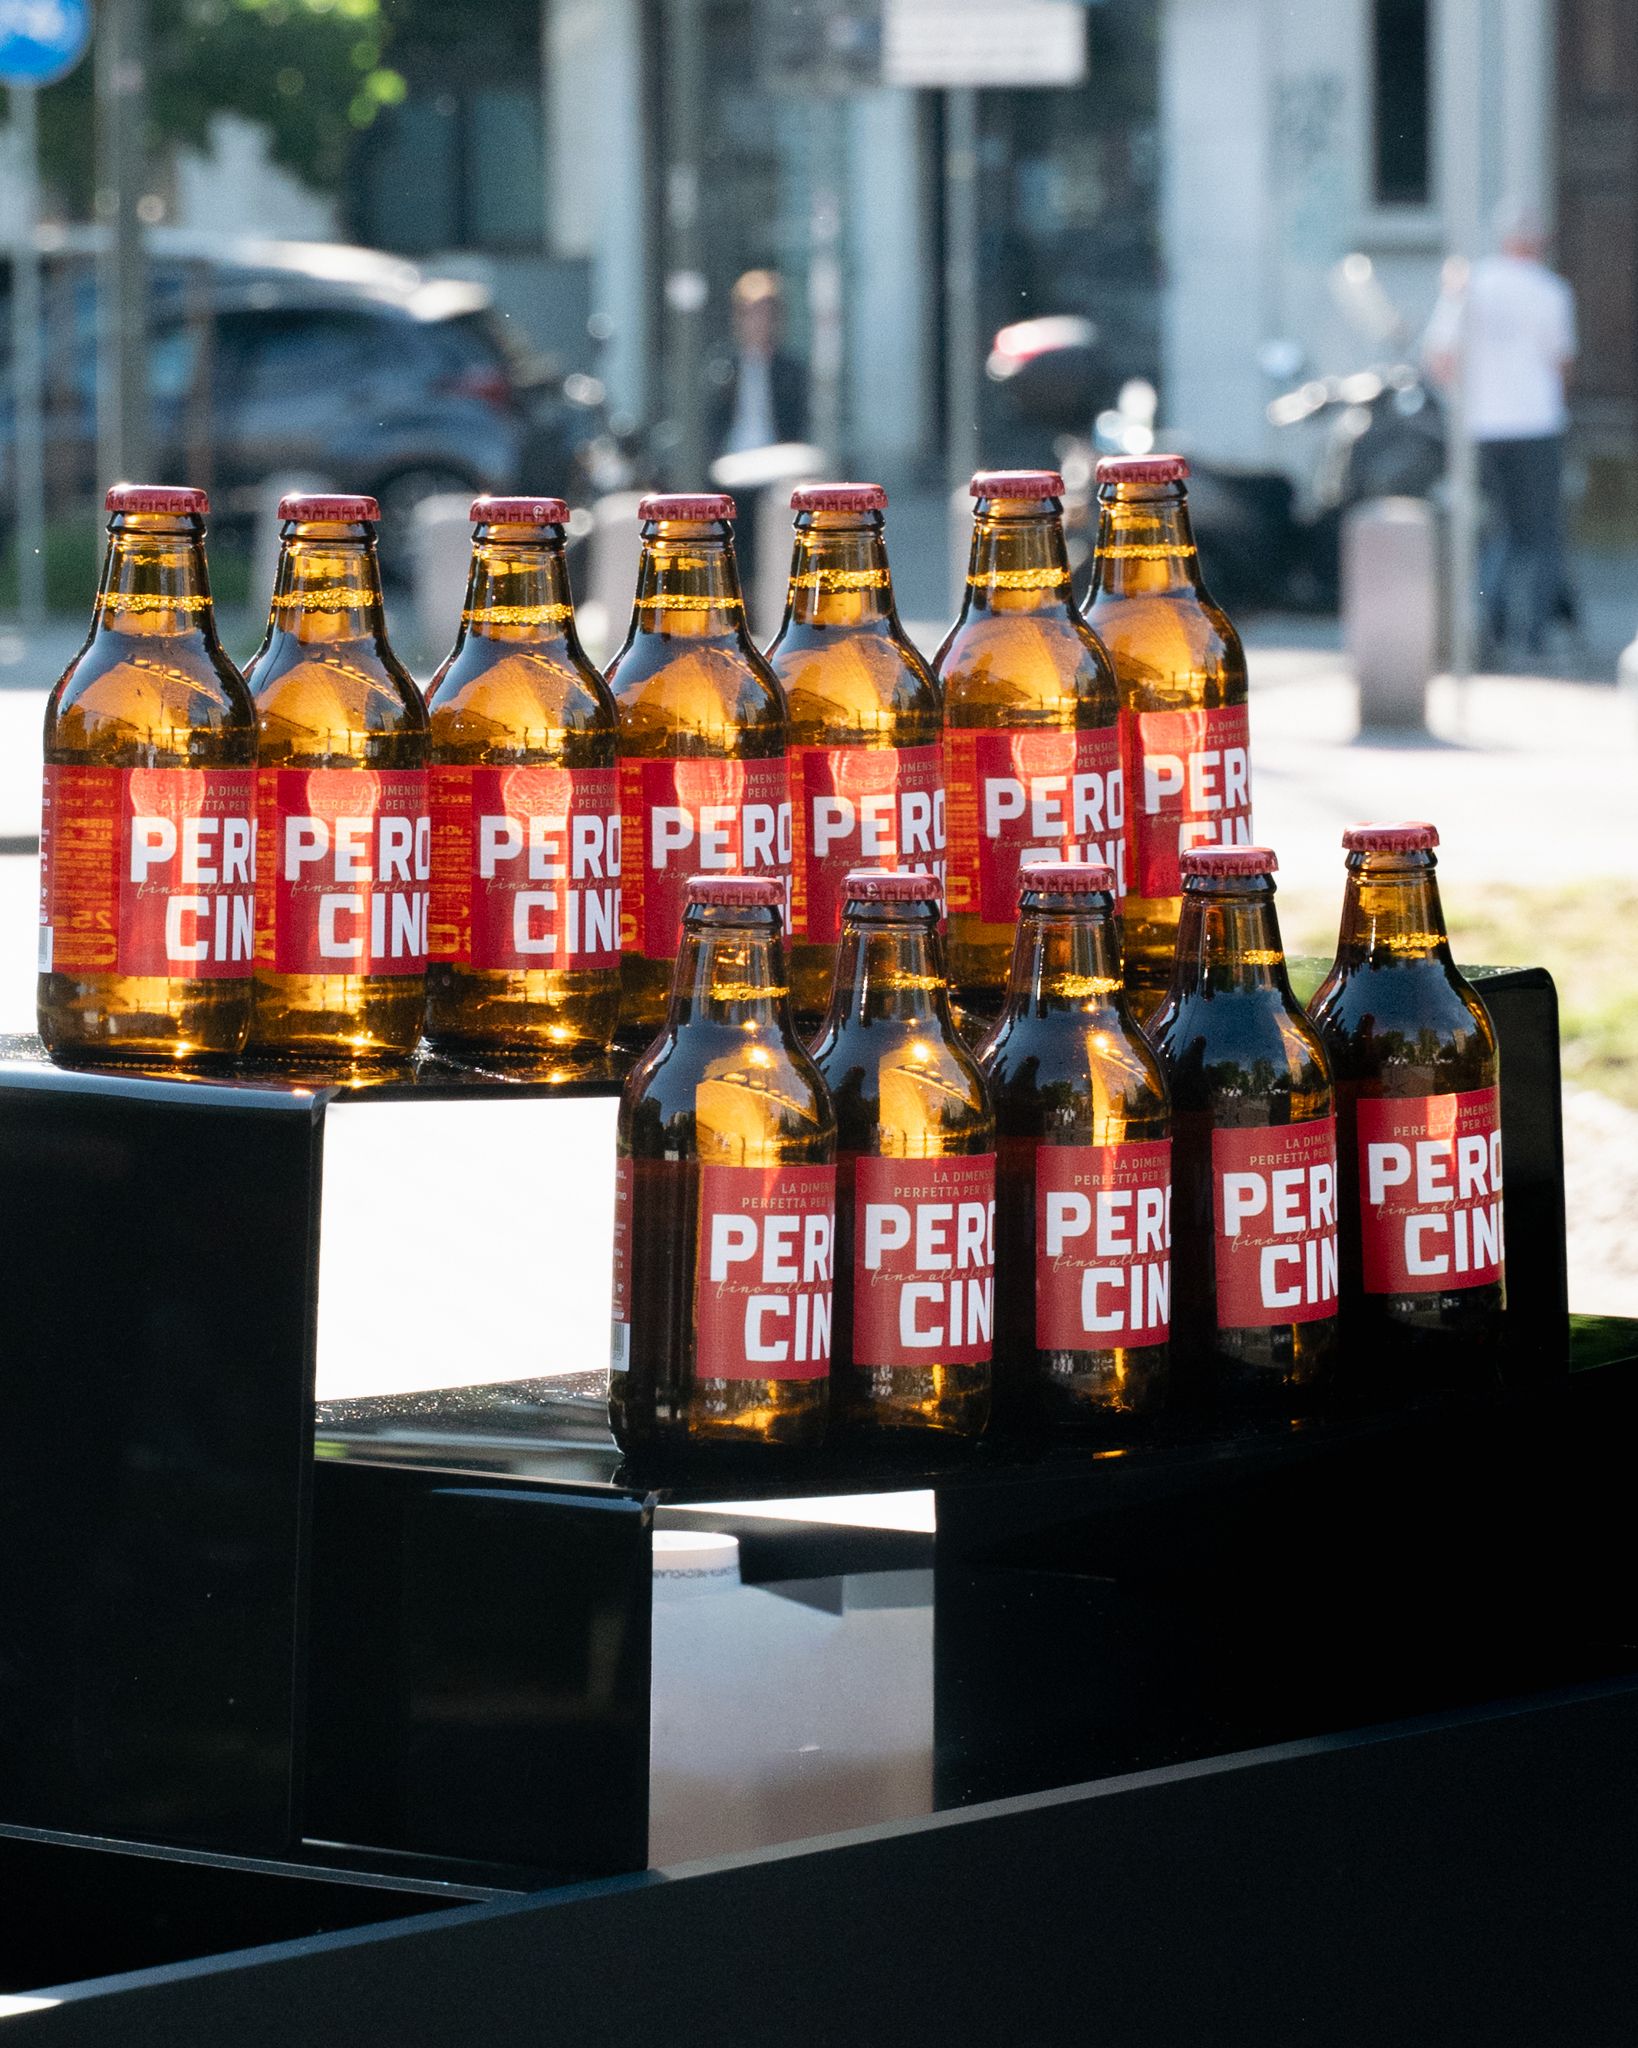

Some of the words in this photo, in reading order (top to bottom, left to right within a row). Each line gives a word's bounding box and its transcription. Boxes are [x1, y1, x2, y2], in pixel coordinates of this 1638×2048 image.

[1077, 757, 1096, 769] PER
[906, 776, 924, 787] PER
[1143, 747, 1252, 815] PER
[748, 788, 767, 799] PER
[385, 800, 407, 811] PER
[578, 799, 597, 809] PER
[651, 801, 793, 869] PERO
[285, 816, 431, 882] PERO
[480, 814, 621, 880] PERO
[1462, 1120, 1481, 1131] PER
[1286, 1138, 1300, 1149] LA
[1112, 1159, 1127, 1170] LA
[1250, 1152, 1310, 1166] PERFETTA
[933, 1172, 948, 1183] LA
[1074, 1173, 1139, 1186] PERFETTA
[781, 1183, 796, 1194] LA
[894, 1187, 960, 1198] PERFETTA
[963, 1186, 980, 1196] PER
[741, 1197, 807, 1208] PERFETTA
[1223, 1160, 1338, 1236] PER
[1376, 1200, 1424, 1221] fino
[1231, 1230, 1279, 1253] fino
[1405, 1200, 1505, 1276] CIN
[710, 1214, 835, 1283] PER
[1053, 1252, 1102, 1273] fino
[871, 1265, 921, 1287] fino
[716, 1279, 767, 1299] fino
[899, 1277, 994, 1347] CIN
